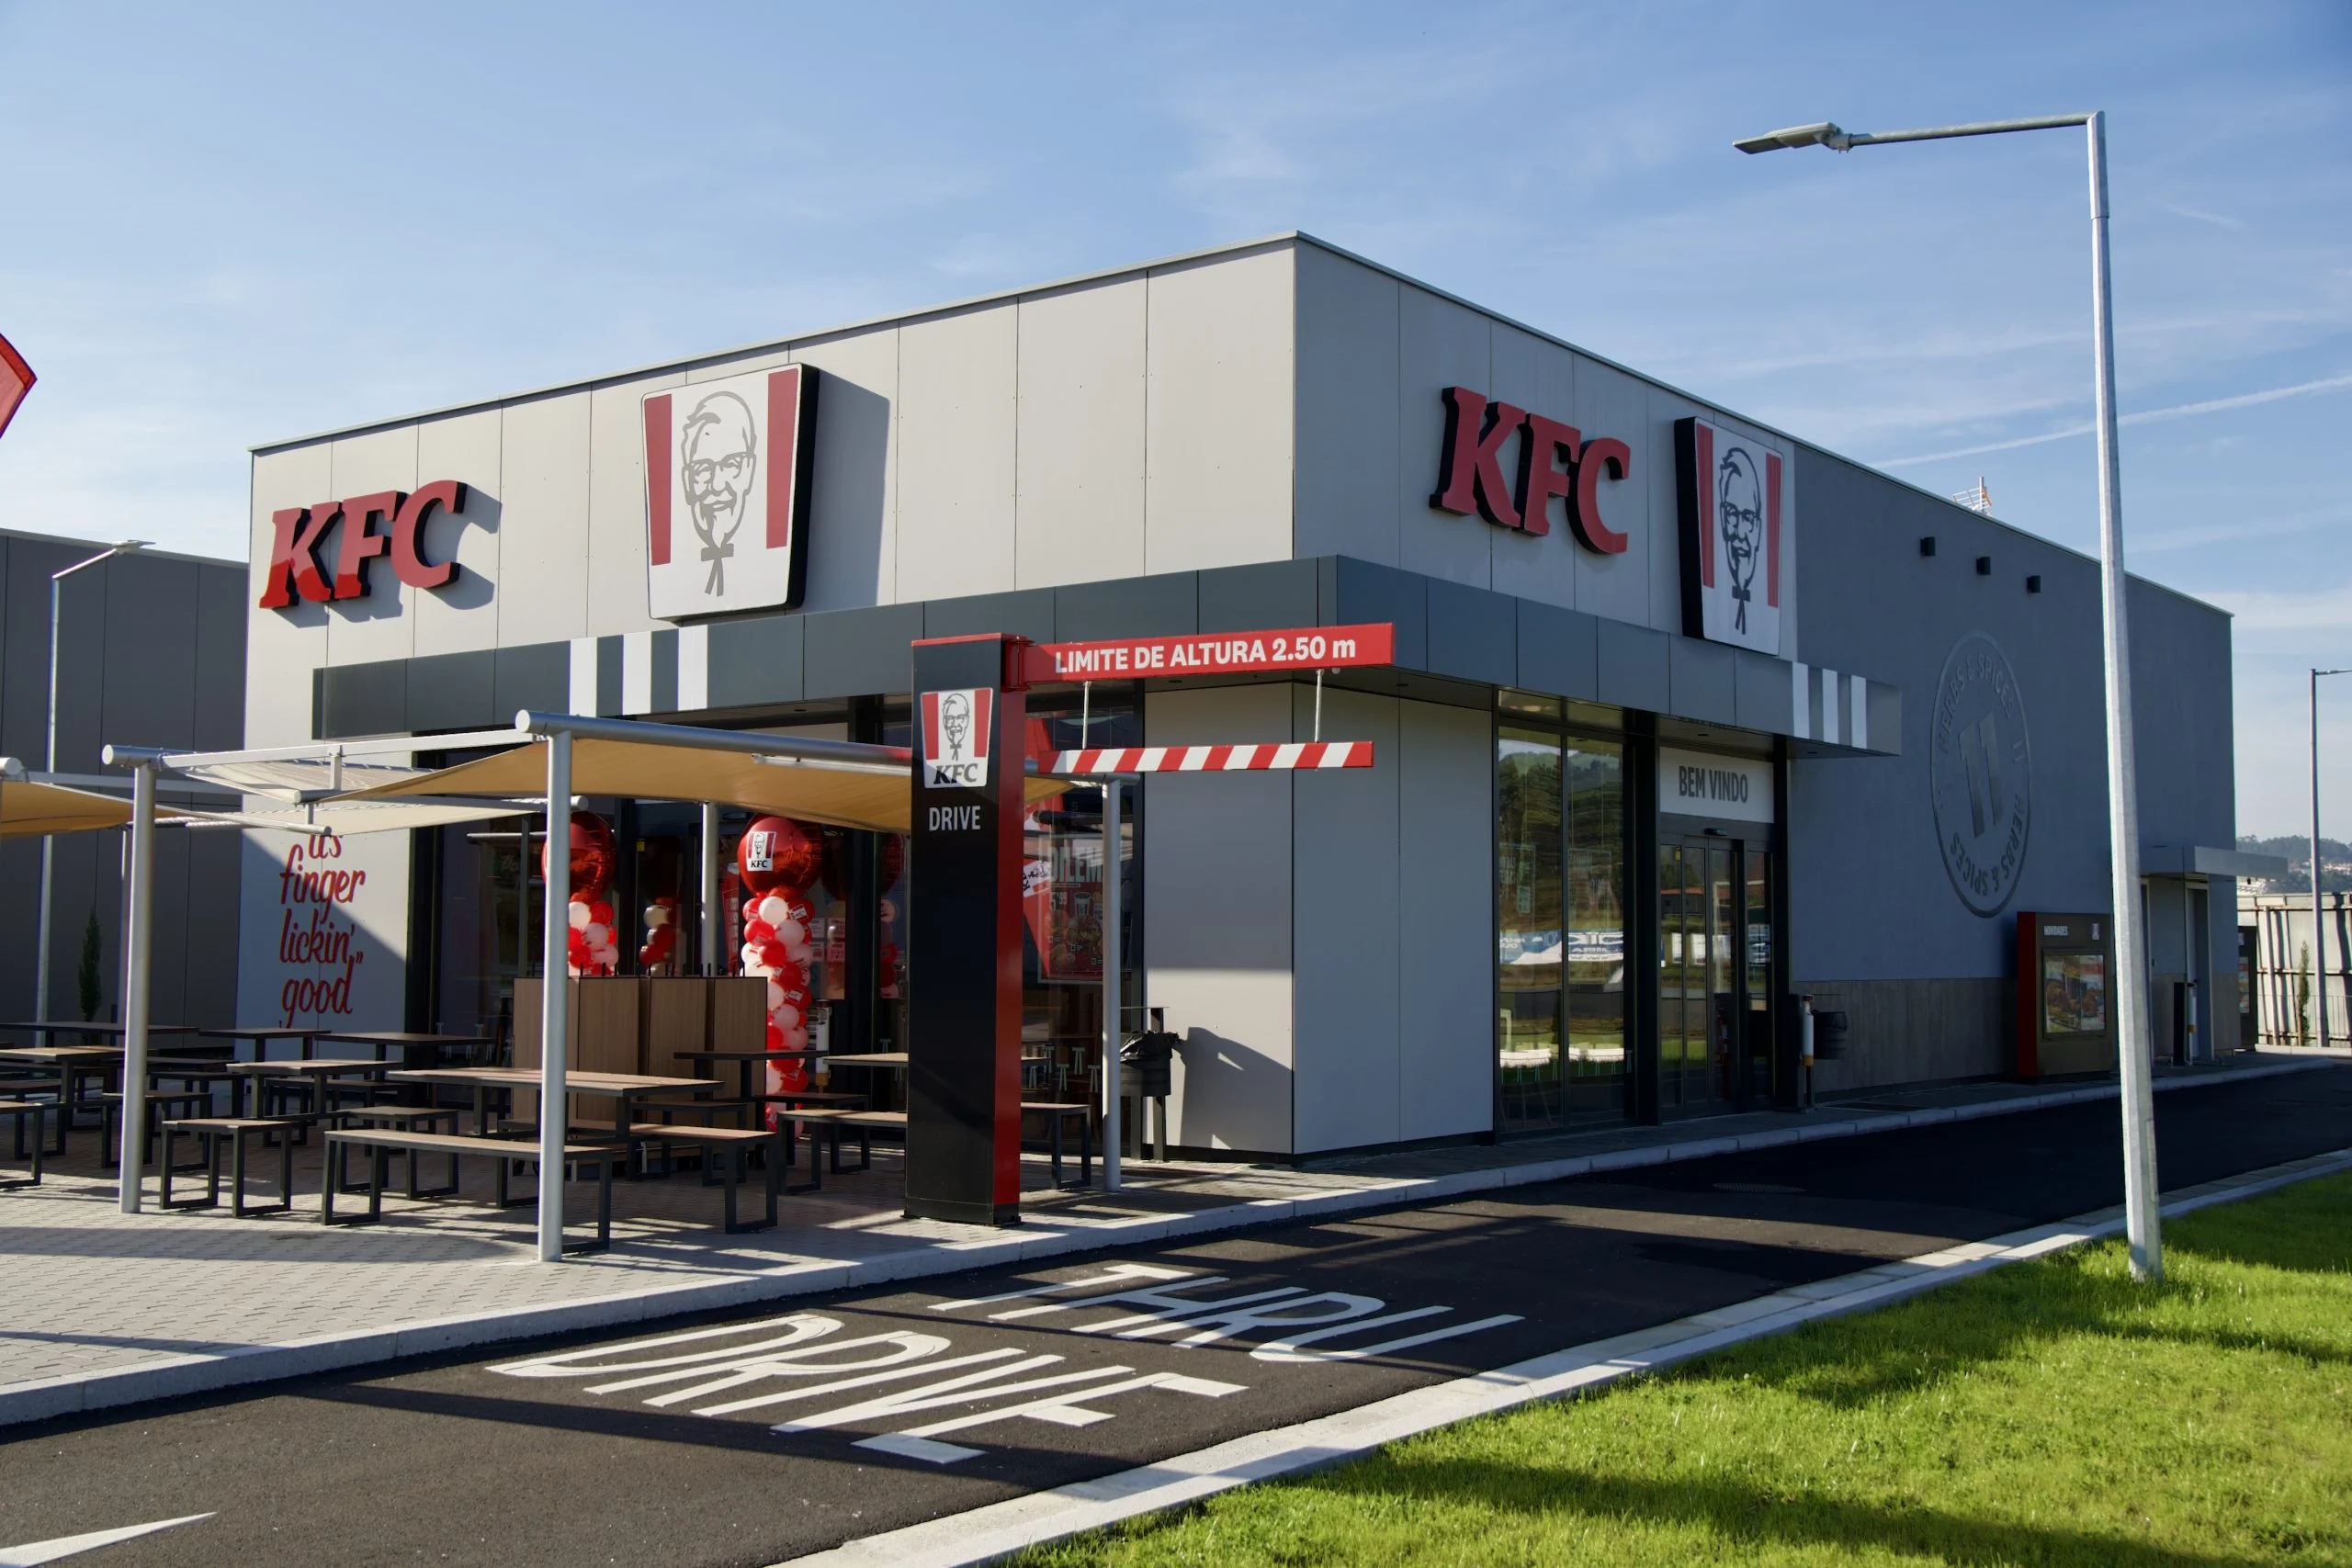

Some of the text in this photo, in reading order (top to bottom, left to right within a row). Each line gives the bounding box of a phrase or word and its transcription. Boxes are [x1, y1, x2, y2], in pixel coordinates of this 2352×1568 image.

[1430, 386, 1631, 554] KFC
[259, 479, 467, 609] KFC
[1056, 636, 1355, 673] LIMITE DE ALTURA 2.50 m
[933, 763, 978, 784] KFC
[1679, 765, 1748, 804] BEM VINDO
[1958, 710, 2004, 840] 11
[929, 805, 980, 831] DRIVE
[279, 843, 366, 925] finger
[750, 860, 769, 868] KFC
[927, 1263, 1526, 1363] THRU
[484, 1313, 1250, 1465] DRIVE
